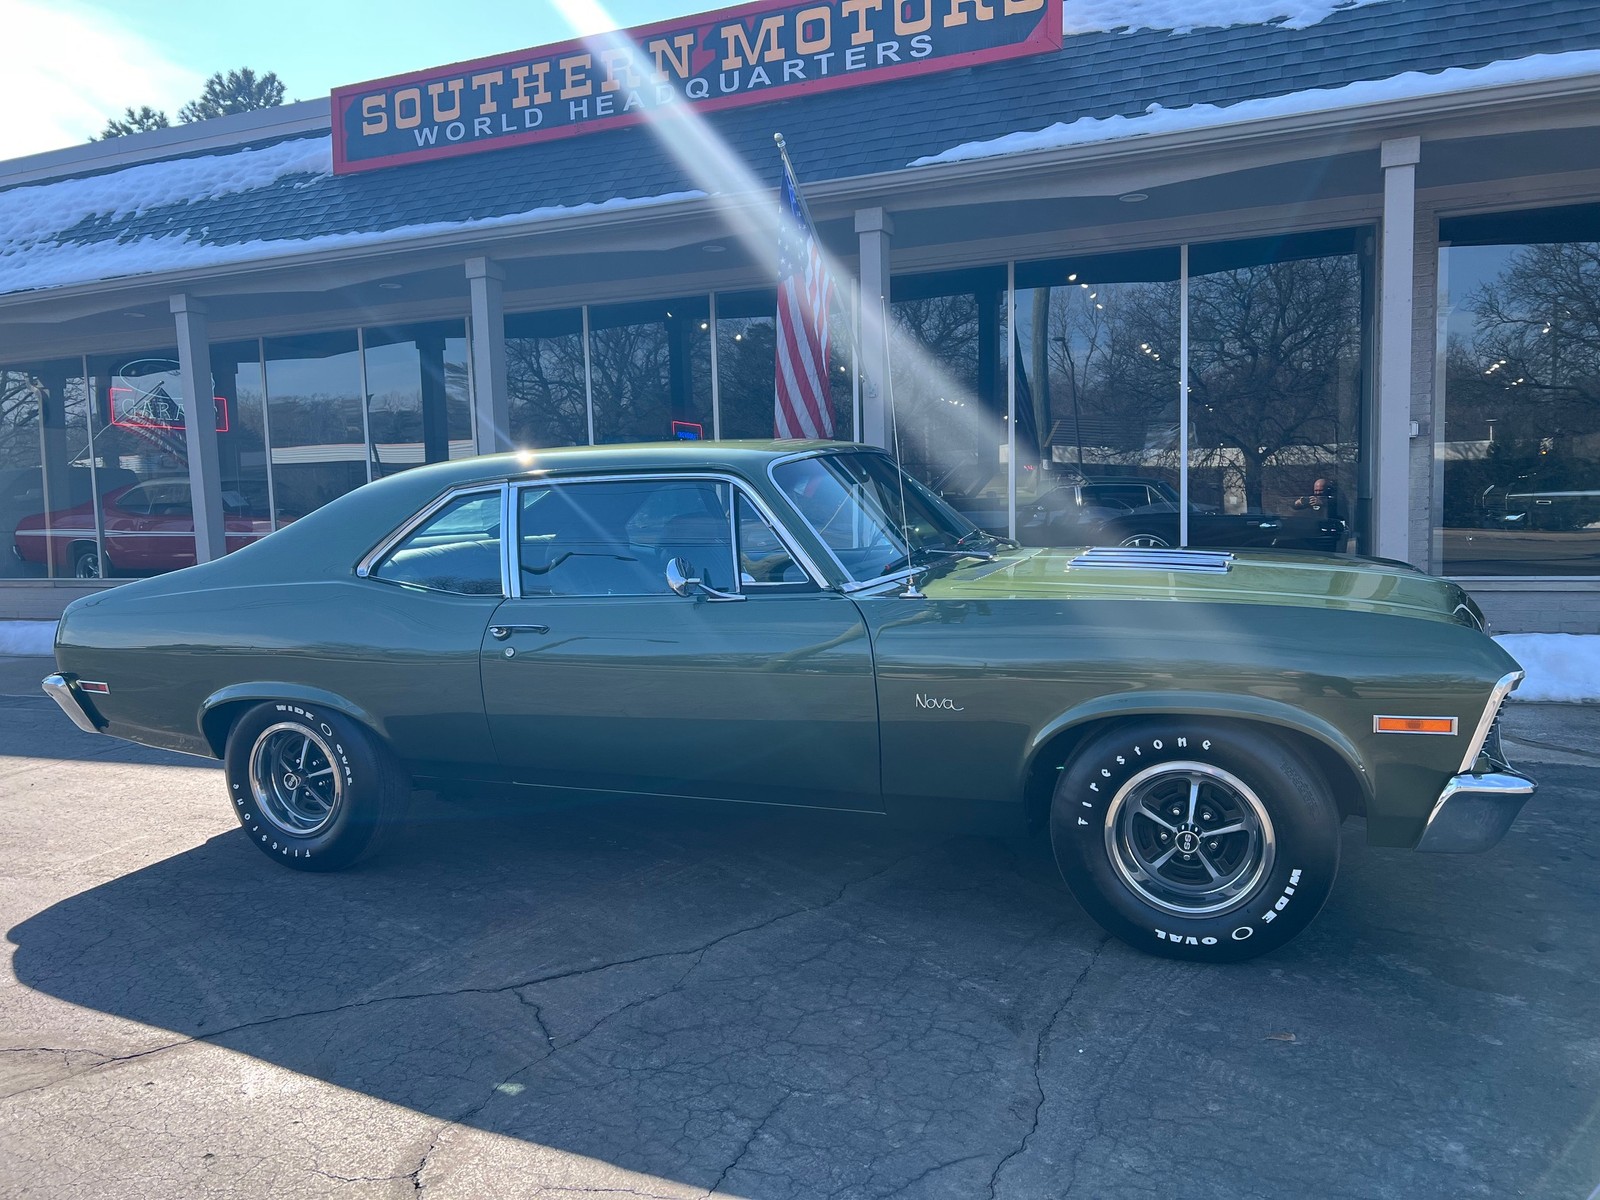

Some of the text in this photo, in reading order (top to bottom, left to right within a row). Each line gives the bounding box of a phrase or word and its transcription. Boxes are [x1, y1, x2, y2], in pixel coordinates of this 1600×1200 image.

[361, 33, 695, 136] SOUTHERN
[413, 34, 933, 147] WORLD HEADQUARTERS
[915, 693, 965, 711] Nova
[276, 704, 353, 786] WIDE OVAL
[1184, 833, 1192, 850] SS
[1154, 869, 1302, 946] WIDE OVAL
